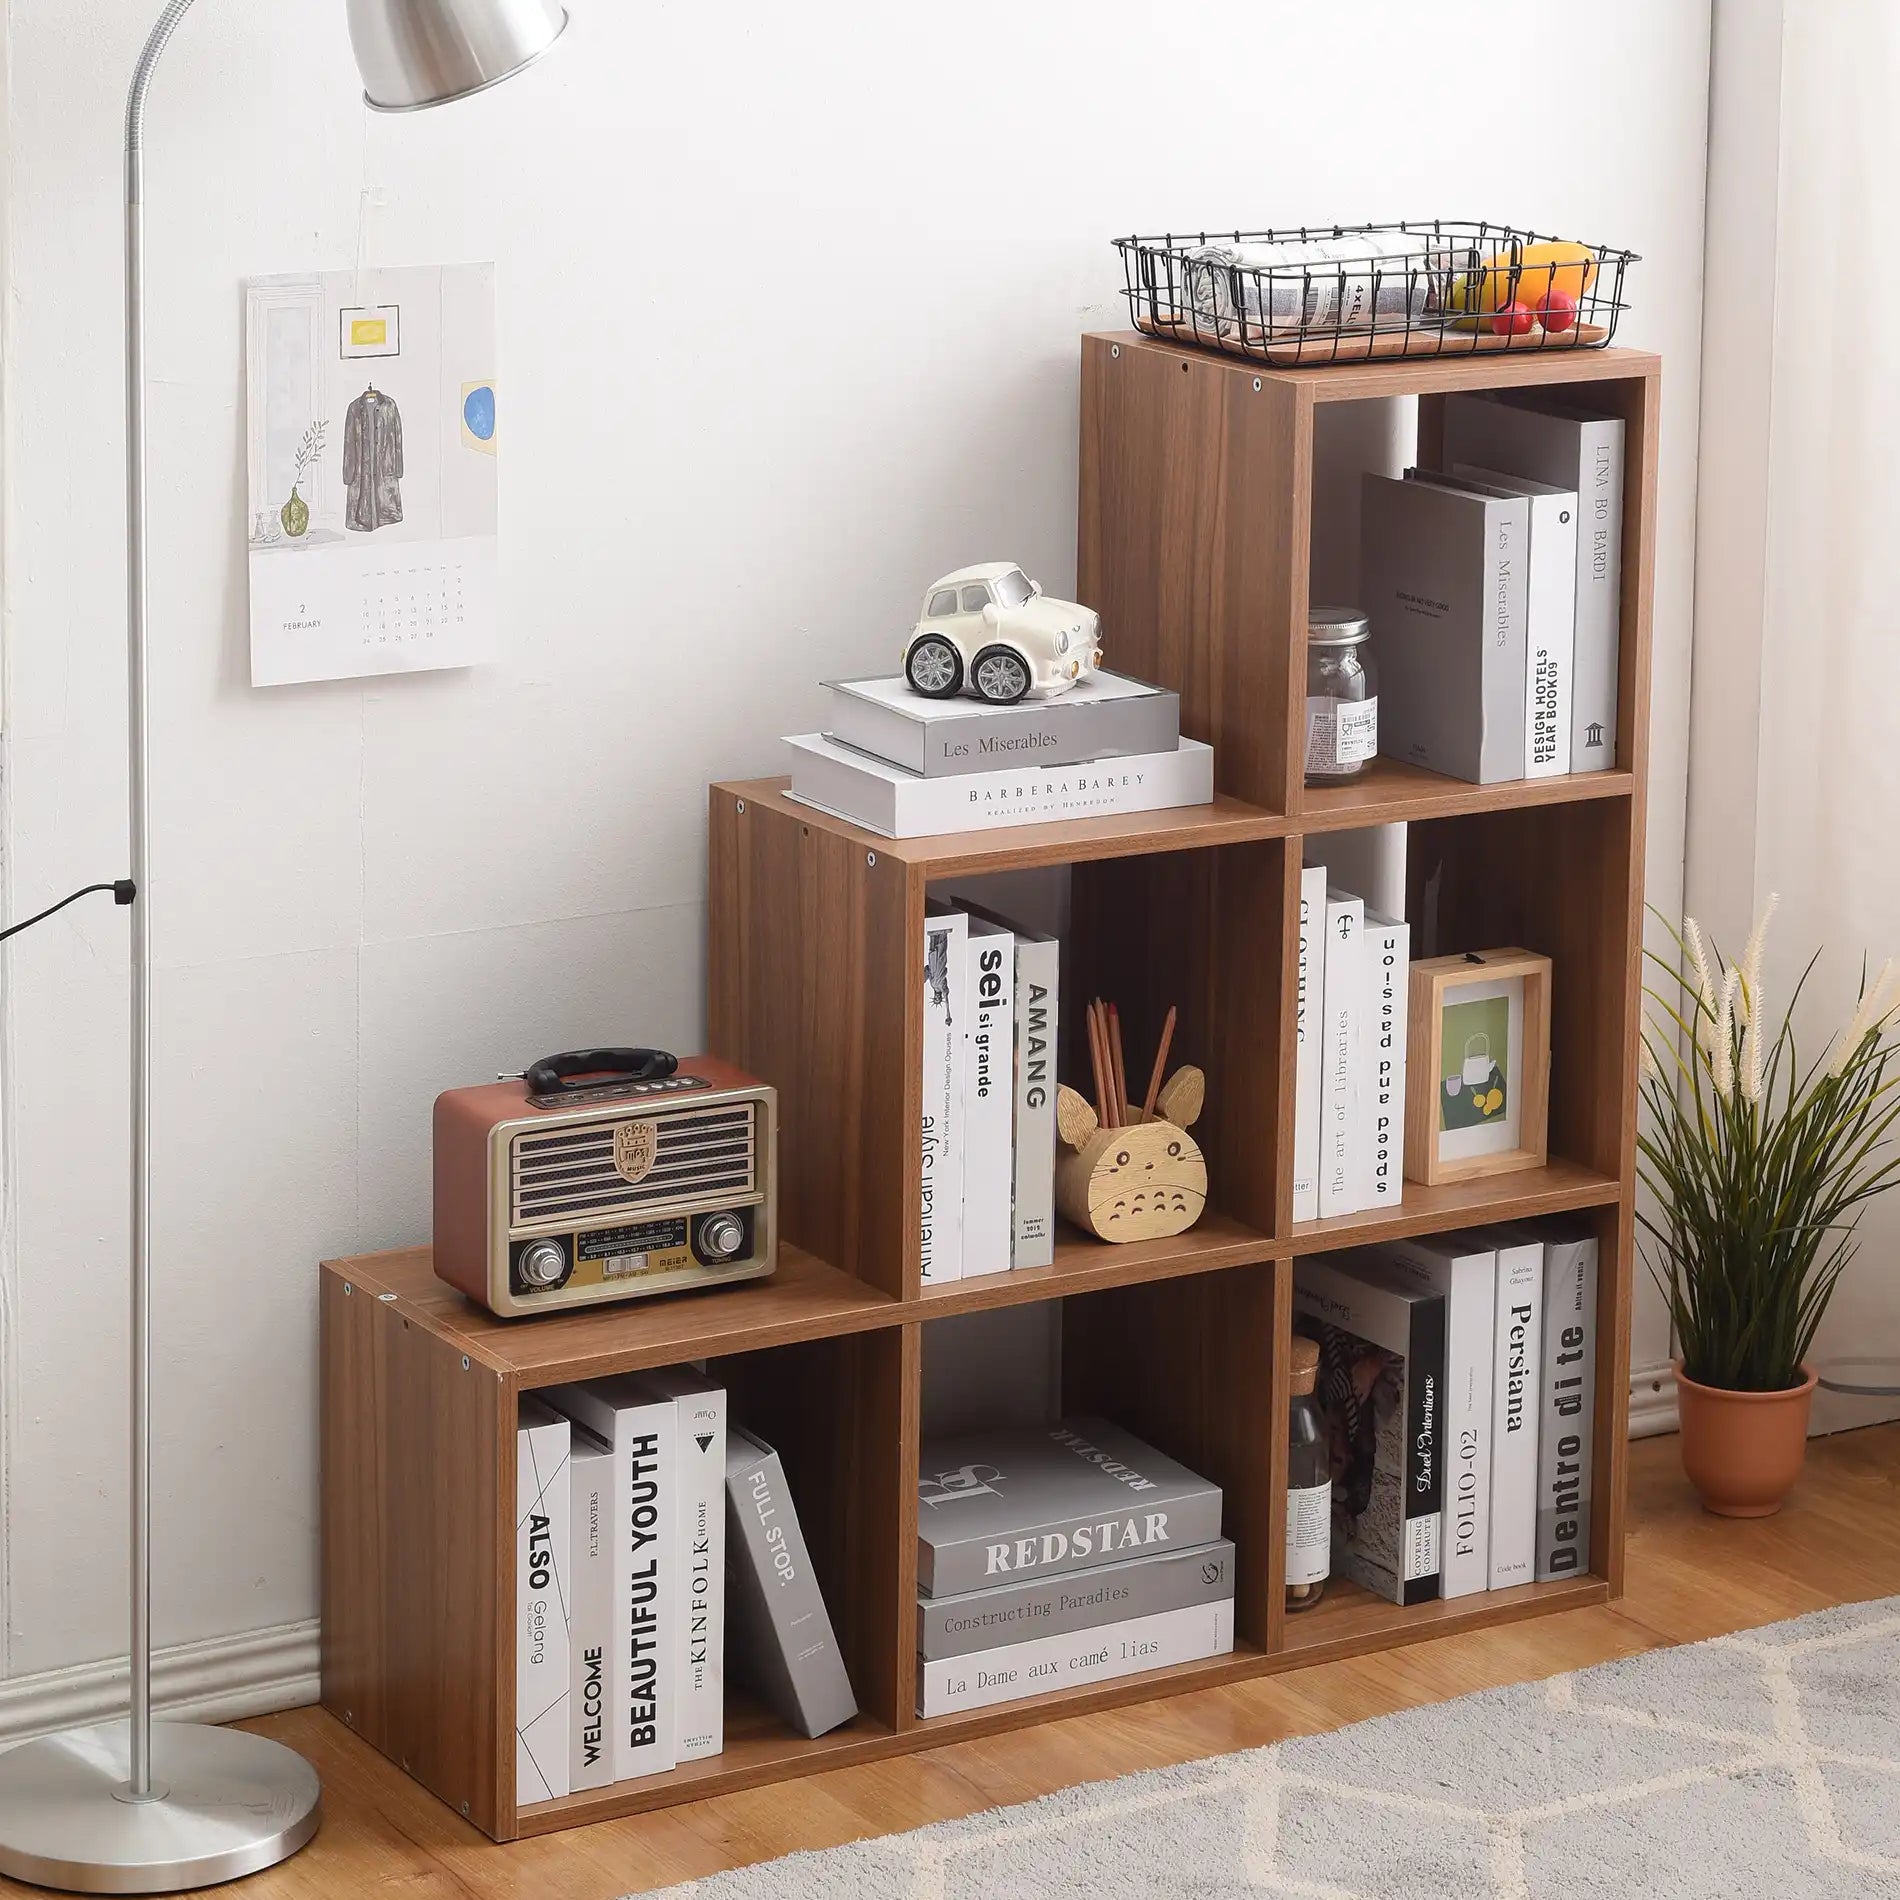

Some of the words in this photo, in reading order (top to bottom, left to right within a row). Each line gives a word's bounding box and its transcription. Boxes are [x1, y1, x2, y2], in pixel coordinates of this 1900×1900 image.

[1594, 498, 1608, 520] BO
[1499, 521, 1512, 550] Les
[1592, 530, 1607, 583] BARDI
[283, 619, 321, 631] FEBRUARY
[300, 604, 306, 614] 2
[1497, 560, 1511, 647] Miserables
[943, 741, 969, 758] Les
[979, 733, 1058, 754] Miserables
[1534, 711, 1545, 763] DESIGN
[1546, 725, 1556, 761] YEAR
[969, 784, 1068, 802] BARBERA
[1079, 774, 1144, 791] BAREY
[987, 806, 1036, 816] REALIZED
[978, 949, 1008, 1010] sei
[1380, 938, 1396, 1049] passion
[980, 1013, 993, 1030] si
[1026, 983, 1046, 1110] AMANG
[943, 1064, 952, 1090] Design
[976, 1034, 990, 1098] grande
[1335, 1010, 1349, 1094] libraries
[943, 1092, 951, 1119] Interior
[1379, 1060, 1391, 1105] and
[1336, 1103, 1346, 1122] of
[942, 1140, 950, 1157] New
[1335, 1131, 1344, 1159] art
[1376, 1116, 1389, 1194] speed
[1332, 1167, 1344, 1195] The
[529, 1285, 555, 1294] VOLUME
[1507, 1301, 1533, 1434] Persiana
[1557, 1326, 1584, 1365] te
[1416, 1374, 1435, 1450] Intentions
[1554, 1376, 1582, 1417] di
[632, 1433, 659, 1552] YOUTH
[1416, 1447, 1432, 1494] Duel
[1457, 1428, 1479, 1559] FOLIO-02
[698, 1500, 707, 1536] HOME
[748, 1470, 775, 1526] FULL
[766, 1526, 795, 1587] STOP.
[1549, 1434, 1582, 1574] Dentro
[529, 1514, 550, 1590] ALSO
[984, 1512, 1170, 1576] REDSTAR
[1413, 1519, 1423, 1577] COVERING
[1423, 1517, 1433, 1573] COMMUTE
[691, 1536, 709, 1666] KINFOLK
[944, 1602, 1052, 1634] Constructing
[1060, 1586, 1129, 1611] Paradies
[531, 1601, 547, 1665] Gelang
[630, 1559, 658, 1749] BEAUTIFUL
[694, 1665, 703, 1690] THE
[946, 1678, 967, 1696] La
[977, 1667, 1018, 1690] Dame
[1028, 1661, 1059, 1678] aux
[1069, 1646, 1108, 1669] camé
[1121, 1638, 1159, 1660] lias
[583, 1645, 603, 1768] WELCOME
